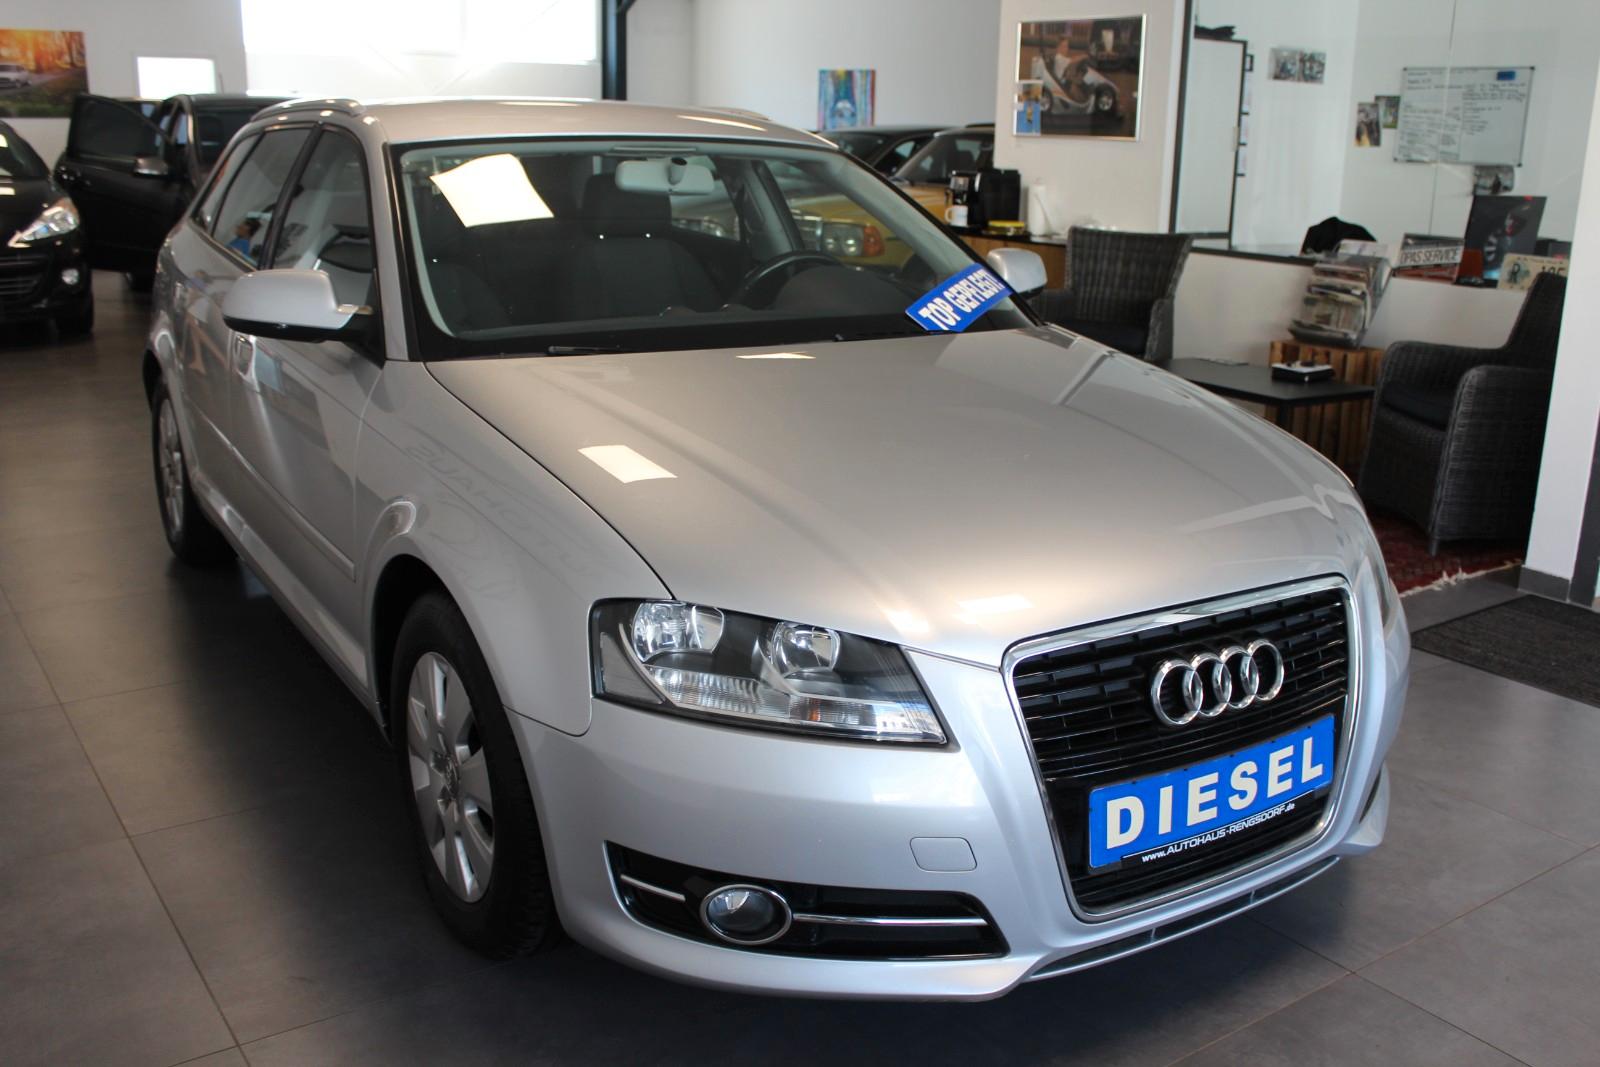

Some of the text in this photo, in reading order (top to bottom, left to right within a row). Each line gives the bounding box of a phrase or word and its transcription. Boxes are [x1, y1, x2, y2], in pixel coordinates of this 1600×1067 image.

[1423, 247, 1459, 262] SERVICE
[918, 297, 961, 331] TOP
[1106, 737, 1324, 850] DIESEL
[1142, 802, 1295, 861] www.AUTOHAUS-RENGSDORF.de
